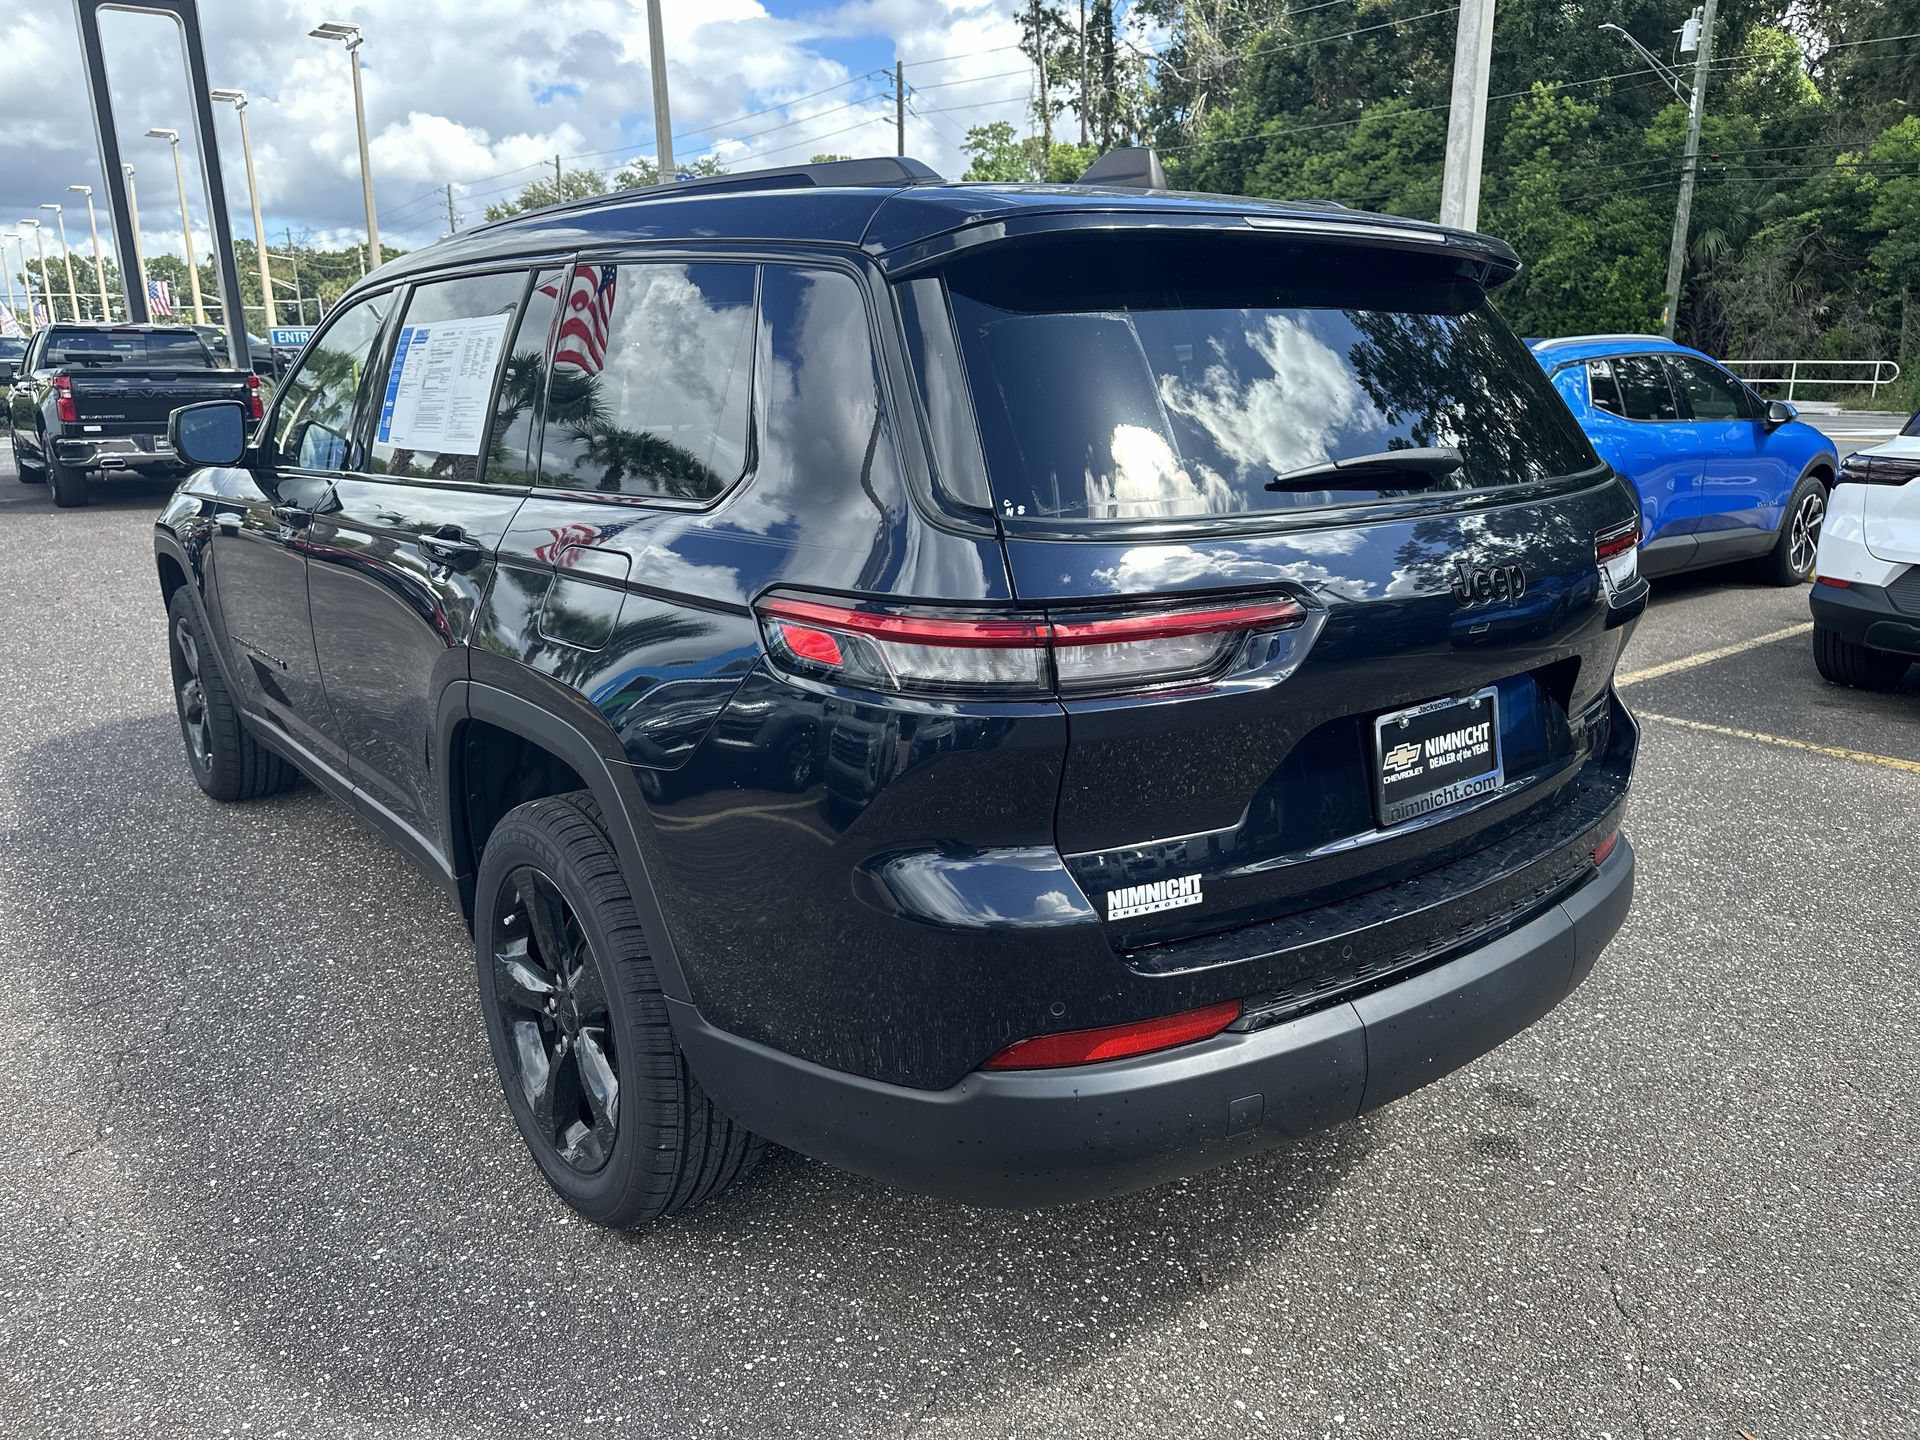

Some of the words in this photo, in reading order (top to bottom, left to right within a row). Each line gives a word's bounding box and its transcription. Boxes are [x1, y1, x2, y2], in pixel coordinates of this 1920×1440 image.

[277, 331, 313, 343] ENTR
[1451, 559, 1526, 609] Jeep
[1425, 722, 1490, 757] NIMNICHT
[1429, 752, 1456, 769] DEALER
[1456, 749, 1463, 763] of
[1463, 748, 1472, 758] the
[1471, 742, 1489, 756] YEAR
[1383, 766, 1423, 784] CHEVROLET
[1390, 775, 1497, 821] nimnicht.com
[1107, 873, 1202, 910] NIMNICHT
[1112, 895, 1199, 917] CHEVROLET
